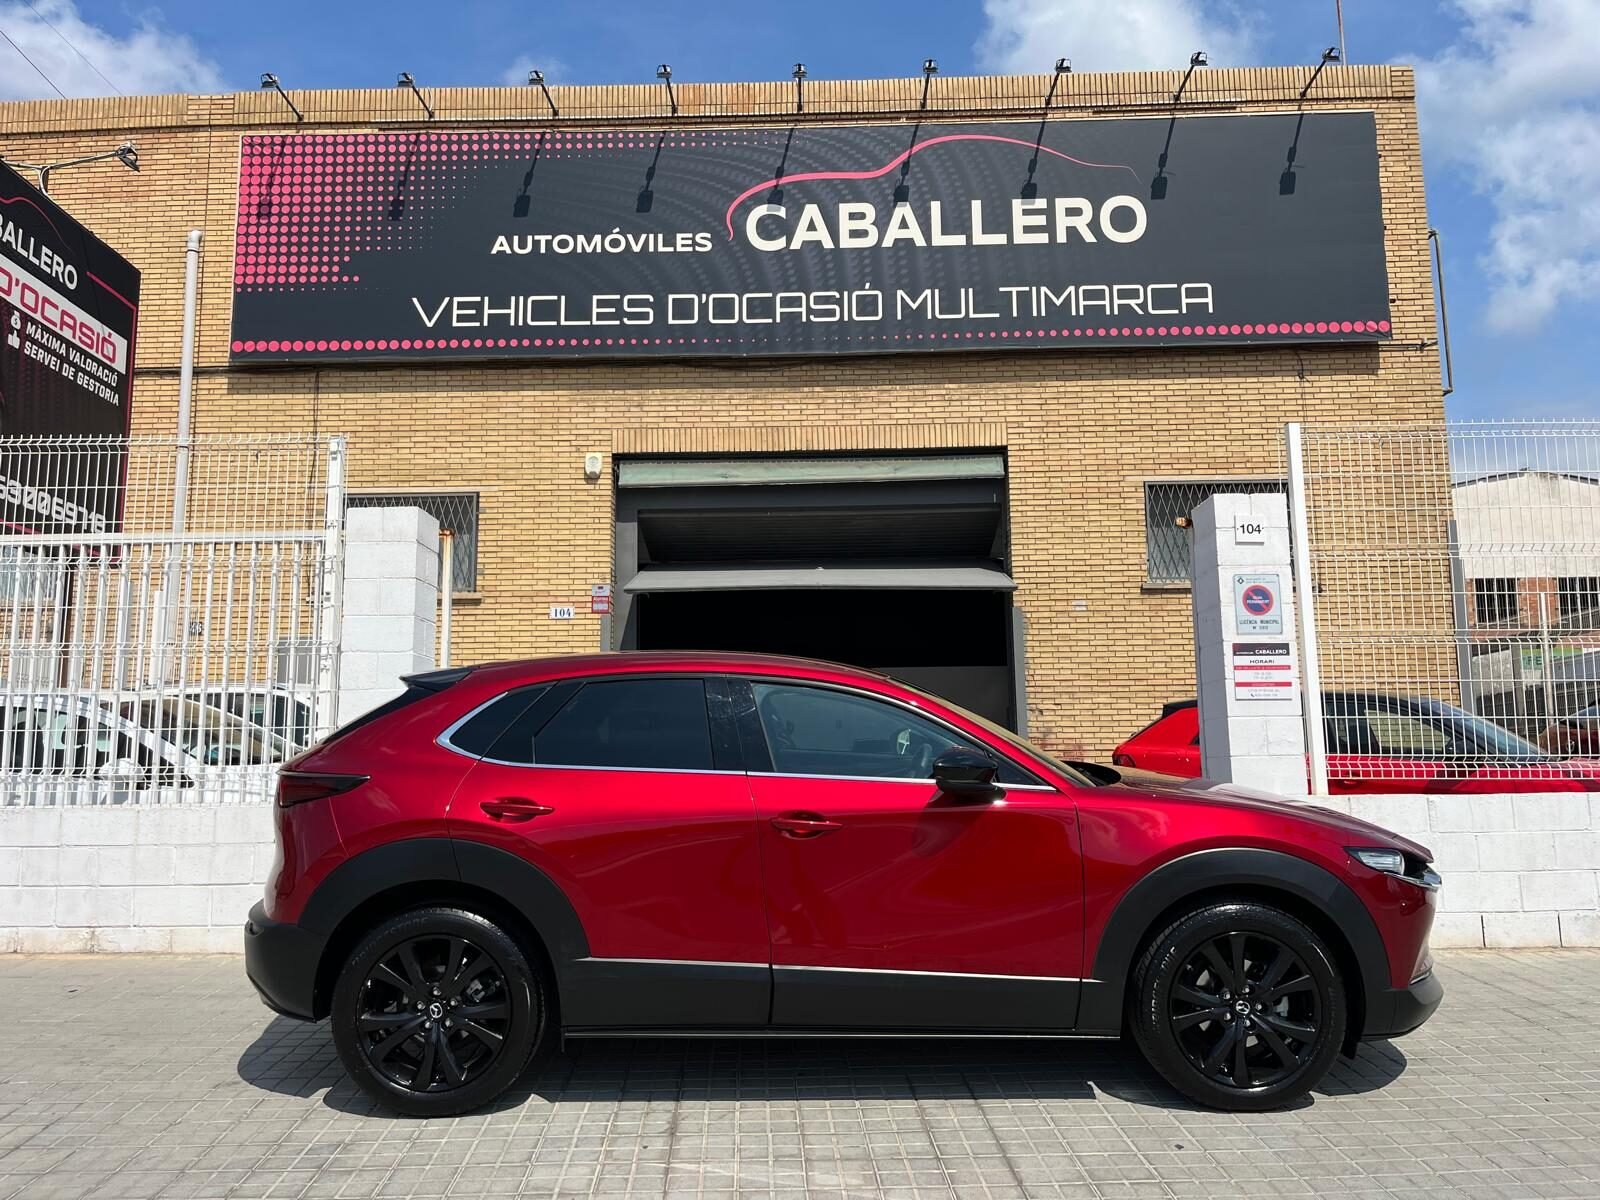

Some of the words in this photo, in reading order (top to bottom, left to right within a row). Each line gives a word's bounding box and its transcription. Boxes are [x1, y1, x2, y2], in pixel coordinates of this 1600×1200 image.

[490, 227, 713, 255] AUTOMÓVILES
[745, 195, 1148, 253] CABALLERO
[411, 293, 654, 327] VEHICLES
[667, 282, 883, 325] D'OCASIÓ
[896, 283, 1214, 320] MULTIMARCA
[24, 341, 60, 372] SERVEI
[62, 363, 76, 381] DE
[77, 374, 119, 406] GESTORIA
[26, 321, 66, 357] MÀXIMA
[69, 347, 118, 387] VALORACIÓ
[1240, 523, 1262, 534] 104
[554, 608, 571, 618] 104
